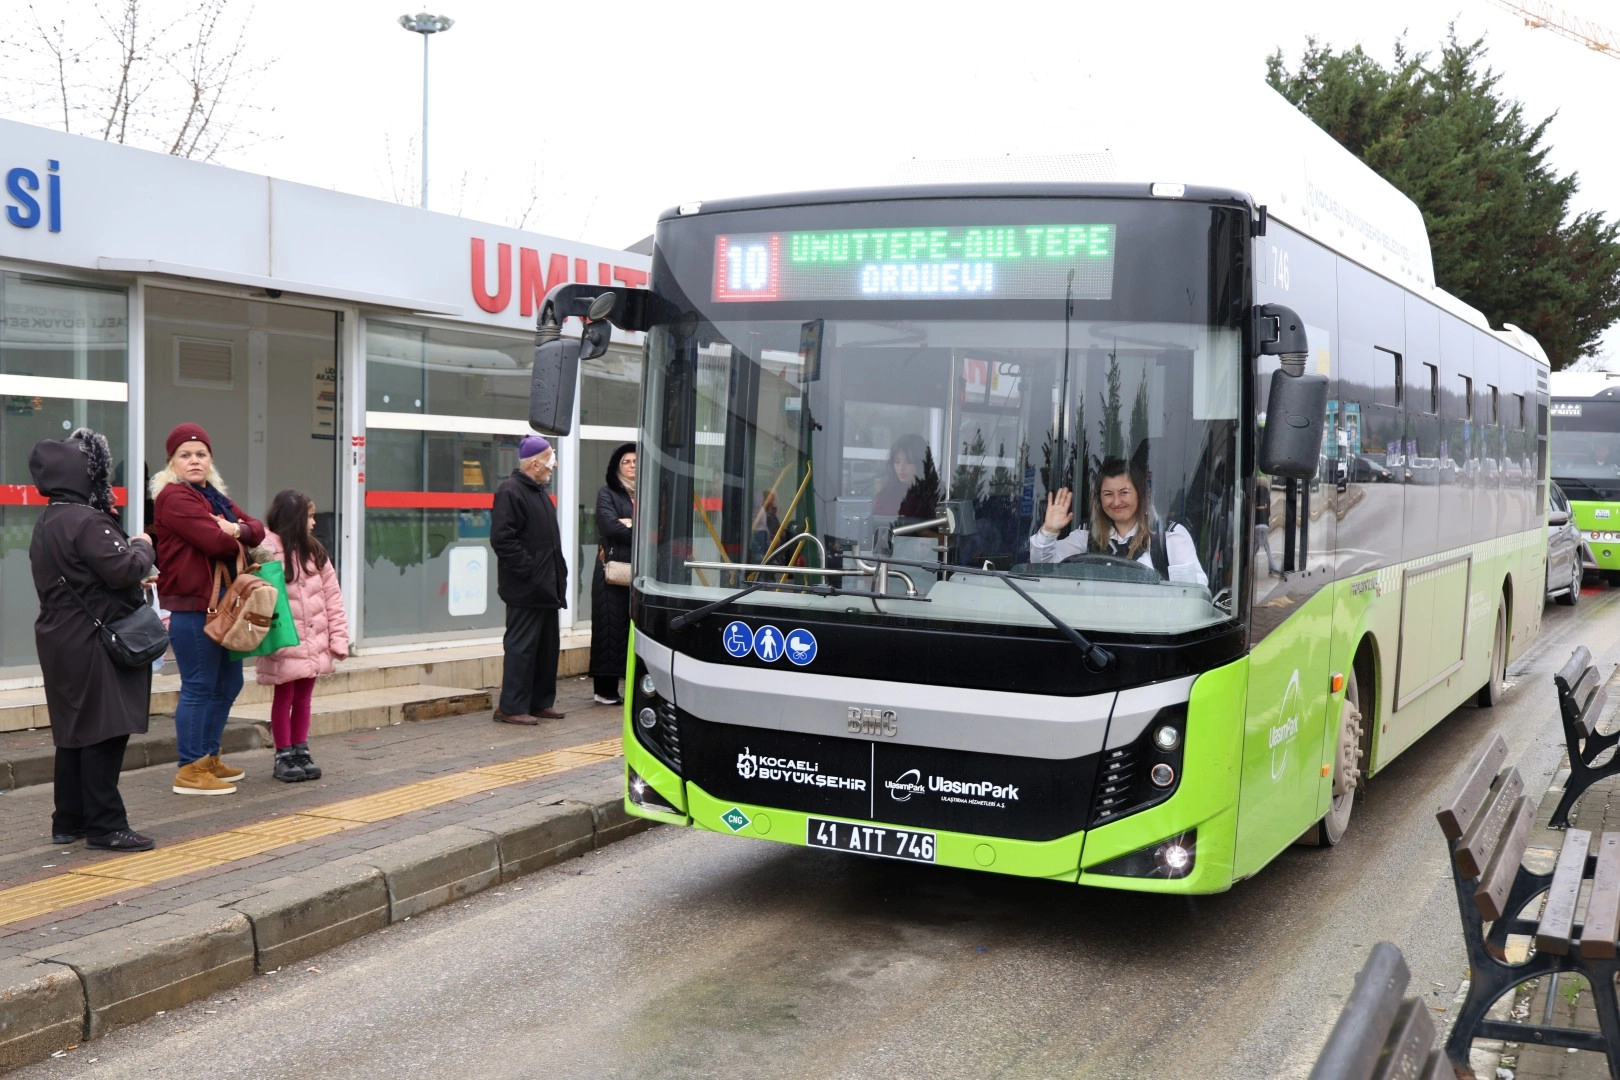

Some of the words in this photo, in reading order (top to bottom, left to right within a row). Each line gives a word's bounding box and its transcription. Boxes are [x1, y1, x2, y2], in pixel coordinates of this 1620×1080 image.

[728, 246, 767, 290] 10
[1272, 245, 1289, 291] 746
[848, 706, 898, 738] BMC
[728, 814, 743, 825] CNG
[816, 822, 836, 846] 41
[850, 826, 886, 853] ATT
[896, 832, 934, 859] 746
